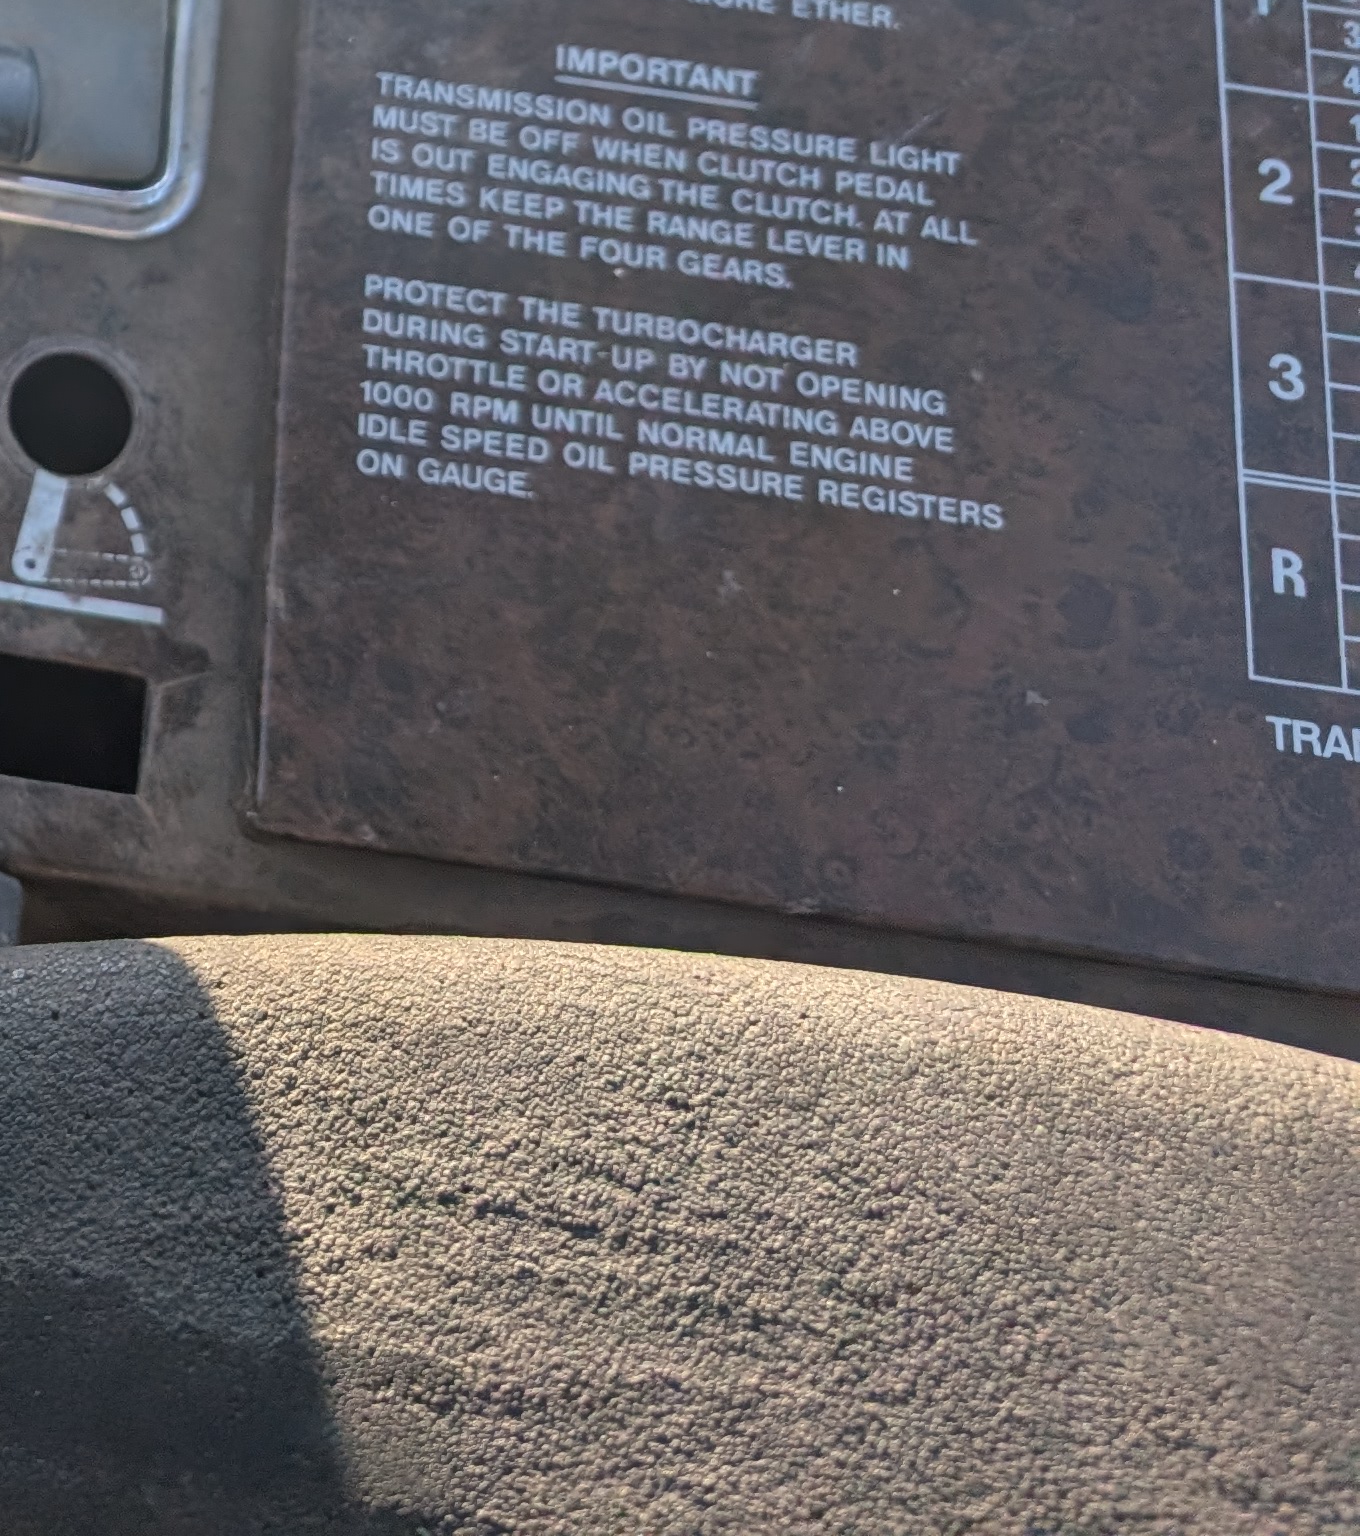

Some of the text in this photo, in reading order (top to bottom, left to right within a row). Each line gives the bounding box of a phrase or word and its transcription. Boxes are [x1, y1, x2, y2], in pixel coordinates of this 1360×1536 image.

[556, 44, 758, 96] IMPORTANT
[373, 104, 934, 206] MUST BE OFF WHEN CLUTCH PEDAL
[376, 72, 962, 175] TRANSMISSION OIL PRESSURE LIGHT
[370, 171, 911, 270] TIMES KEEP THE RANGE LEVER IN
[372, 138, 400, 163] IS
[412, 143, 473, 172] OUT
[488, 154, 651, 199] ENGAGING
[658, 179, 718, 209] THE
[874, 210, 910, 235] AT
[921, 216, 981, 246] ALL
[1258, 157, 1294, 205] 2
[368, 205, 793, 289] ONE OF THE FOUR GEARS.
[362, 308, 486, 348] DURING
[669, 354, 706, 380] BY
[721, 361, 784, 391] NOT
[797, 372, 946, 416] OPENING
[365, 274, 857, 367] PROTECT THE TURBOCHARGER
[362, 344, 955, 453] THROTTLE OR ACCELERATING ABOVE
[1268, 353, 1306, 401] 3
[357, 449, 535, 498] ON GAUGE.
[358, 413, 1005, 530] IDLE SPEED OIL PRESSURE REGISTERS
[360, 380, 913, 482] 1000 RPM UNTIL NORMAL ENGINE
[1271, 547, 1307, 598] R
